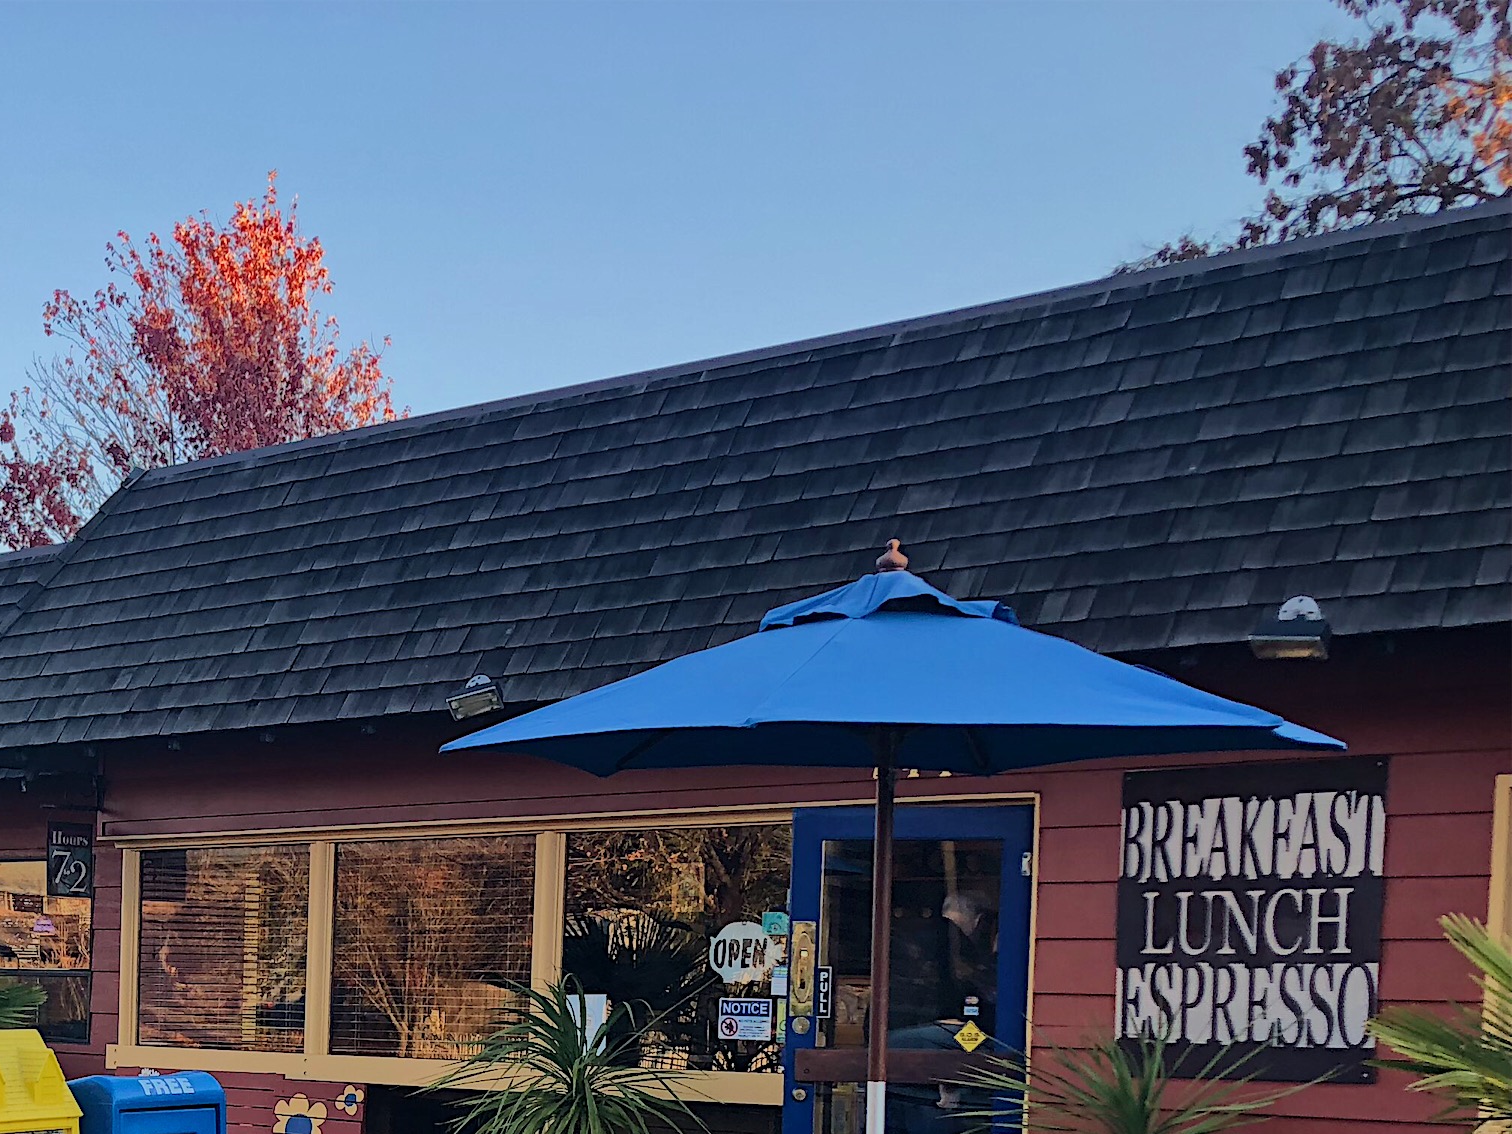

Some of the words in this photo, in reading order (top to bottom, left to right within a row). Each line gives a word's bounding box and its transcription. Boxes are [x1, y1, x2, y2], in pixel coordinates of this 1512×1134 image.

[52, 830, 88, 846] Hours
[1121, 790, 1386, 883] BREAKFAST
[52, 850, 71, 883] 7
[70, 861, 87, 892] 2
[1140, 888, 1355, 955] LUNCH
[713, 938, 768, 968] OPEN
[722, 1003, 768, 1014] NOTICE
[819, 972, 828, 1013] PULL
[1115, 963, 1378, 1049] ESPRESSO
[138, 1077, 195, 1096] FREE
